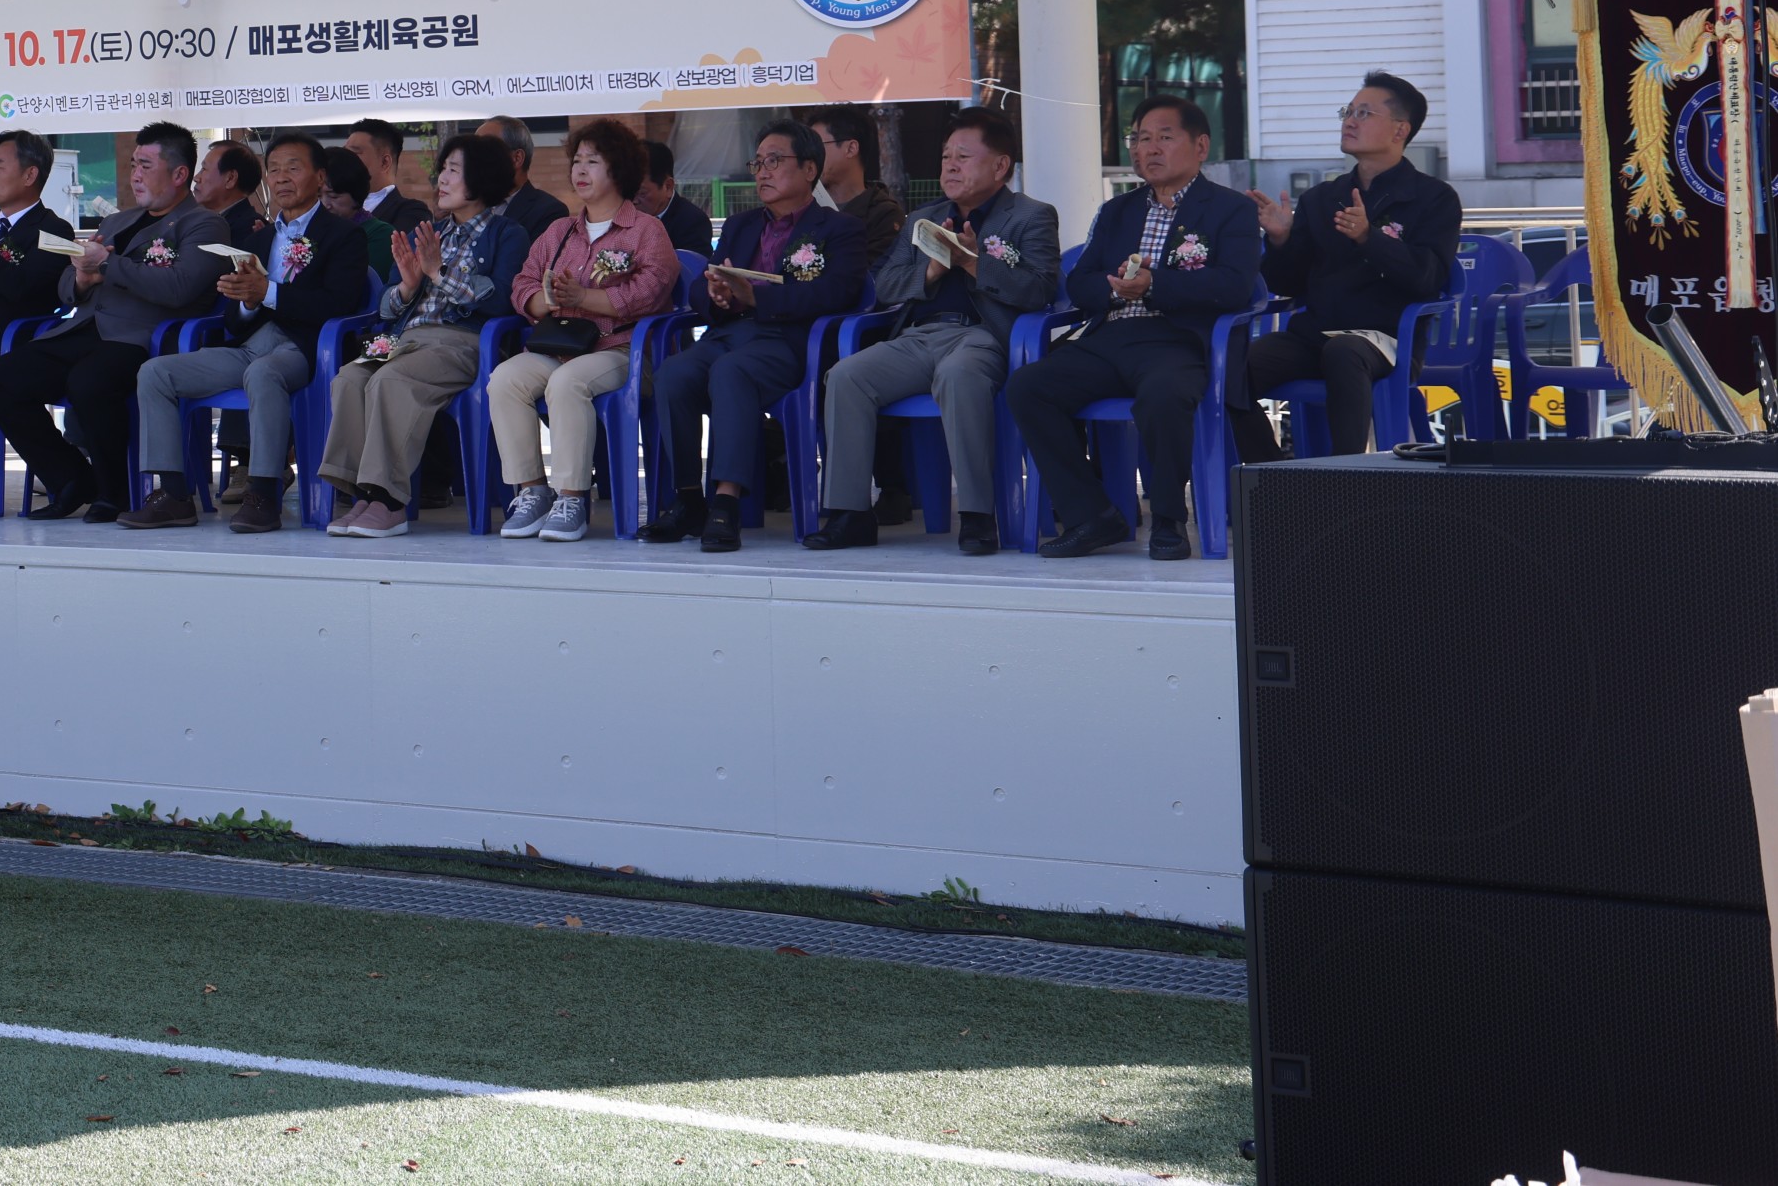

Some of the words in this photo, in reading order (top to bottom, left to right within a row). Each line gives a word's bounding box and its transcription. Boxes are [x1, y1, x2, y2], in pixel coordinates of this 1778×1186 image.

[828, 1, 861, 18] Young
[4, 31, 47, 67] 10.
[139, 26, 216, 60] 09:30
[225, 25, 238, 60] /
[247, 14, 479, 58] 매포생활체육공원
[17, 91, 173, 114] 단양시멘트기금관리위원회
[186, 86, 290, 107] 매포읍이장협의회
[302, 83, 370, 103] 한일시멘트
[383, 80, 439, 99] 성신양회
[451, 79, 494, 97] GRM,
[506, 73, 594, 94] 에스피네이처
[608, 71, 662, 89] 태경BK
[675, 67, 737, 87] 삼보광업
[751, 63, 814, 84] 흥덕기업
